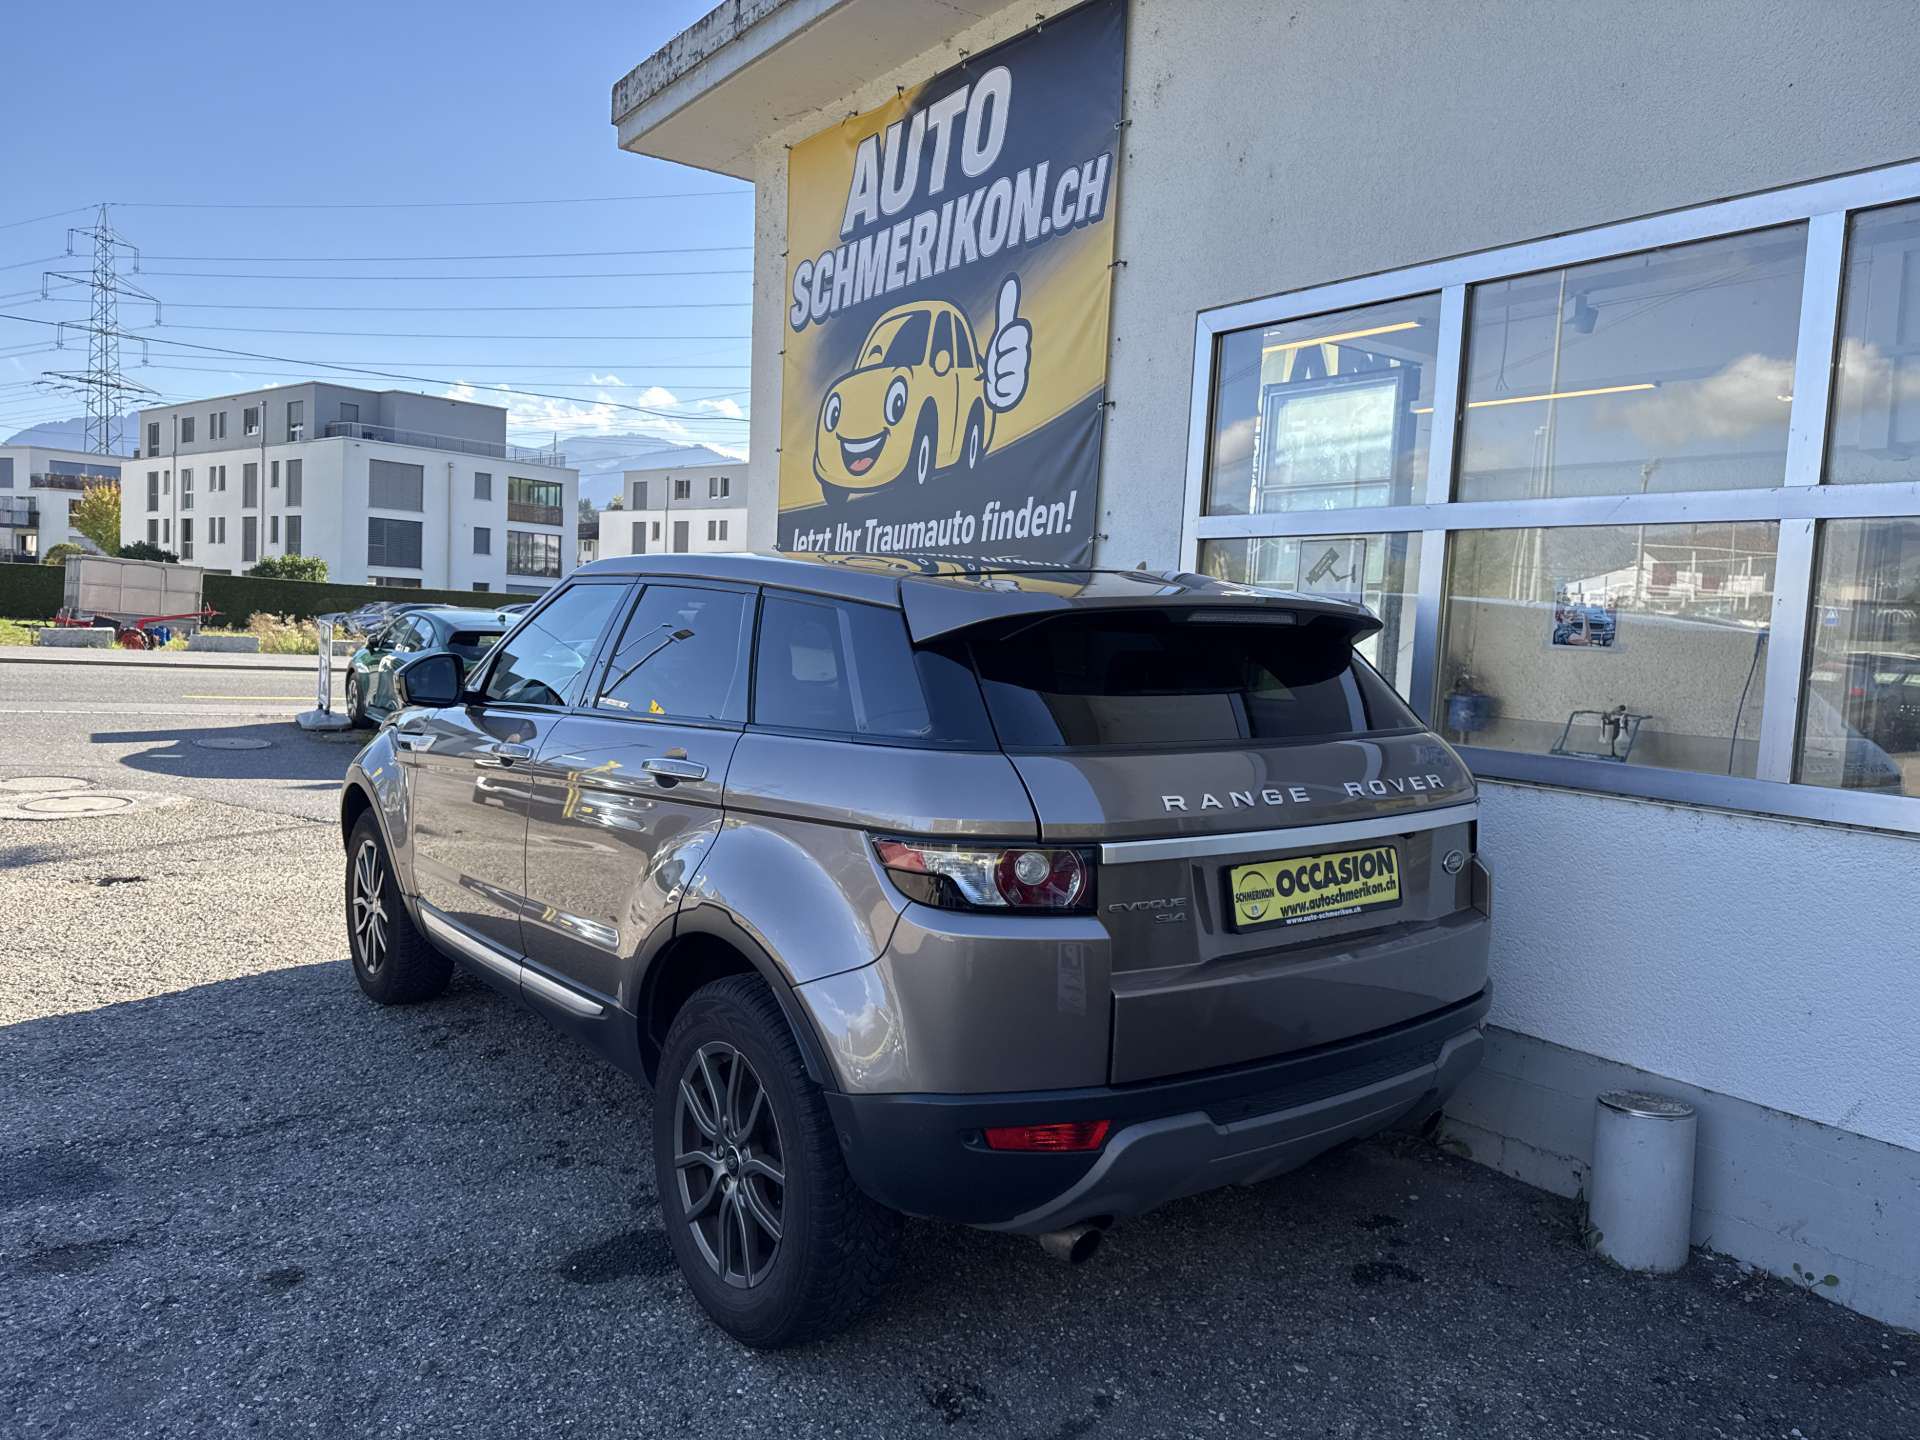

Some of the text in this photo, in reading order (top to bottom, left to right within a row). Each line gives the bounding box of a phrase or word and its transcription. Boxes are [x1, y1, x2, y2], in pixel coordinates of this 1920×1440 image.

[840, 65, 1013, 237] AUTO
[790, 153, 1110, 328] SCHMERIKON.CH
[834, 522, 862, 553] Ihr
[865, 510, 975, 553] Traumauto
[981, 490, 1078, 543] finden!
[1161, 773, 1445, 812] RANGE ROVER
[1275, 849, 1394, 897] OCCASION
[1235, 887, 1275, 904] SCHMERIKON
[1280, 876, 1397, 917] www.autoschmerikon.ch
[1286, 907, 1362, 925] www.auto-schmerikon.ch
